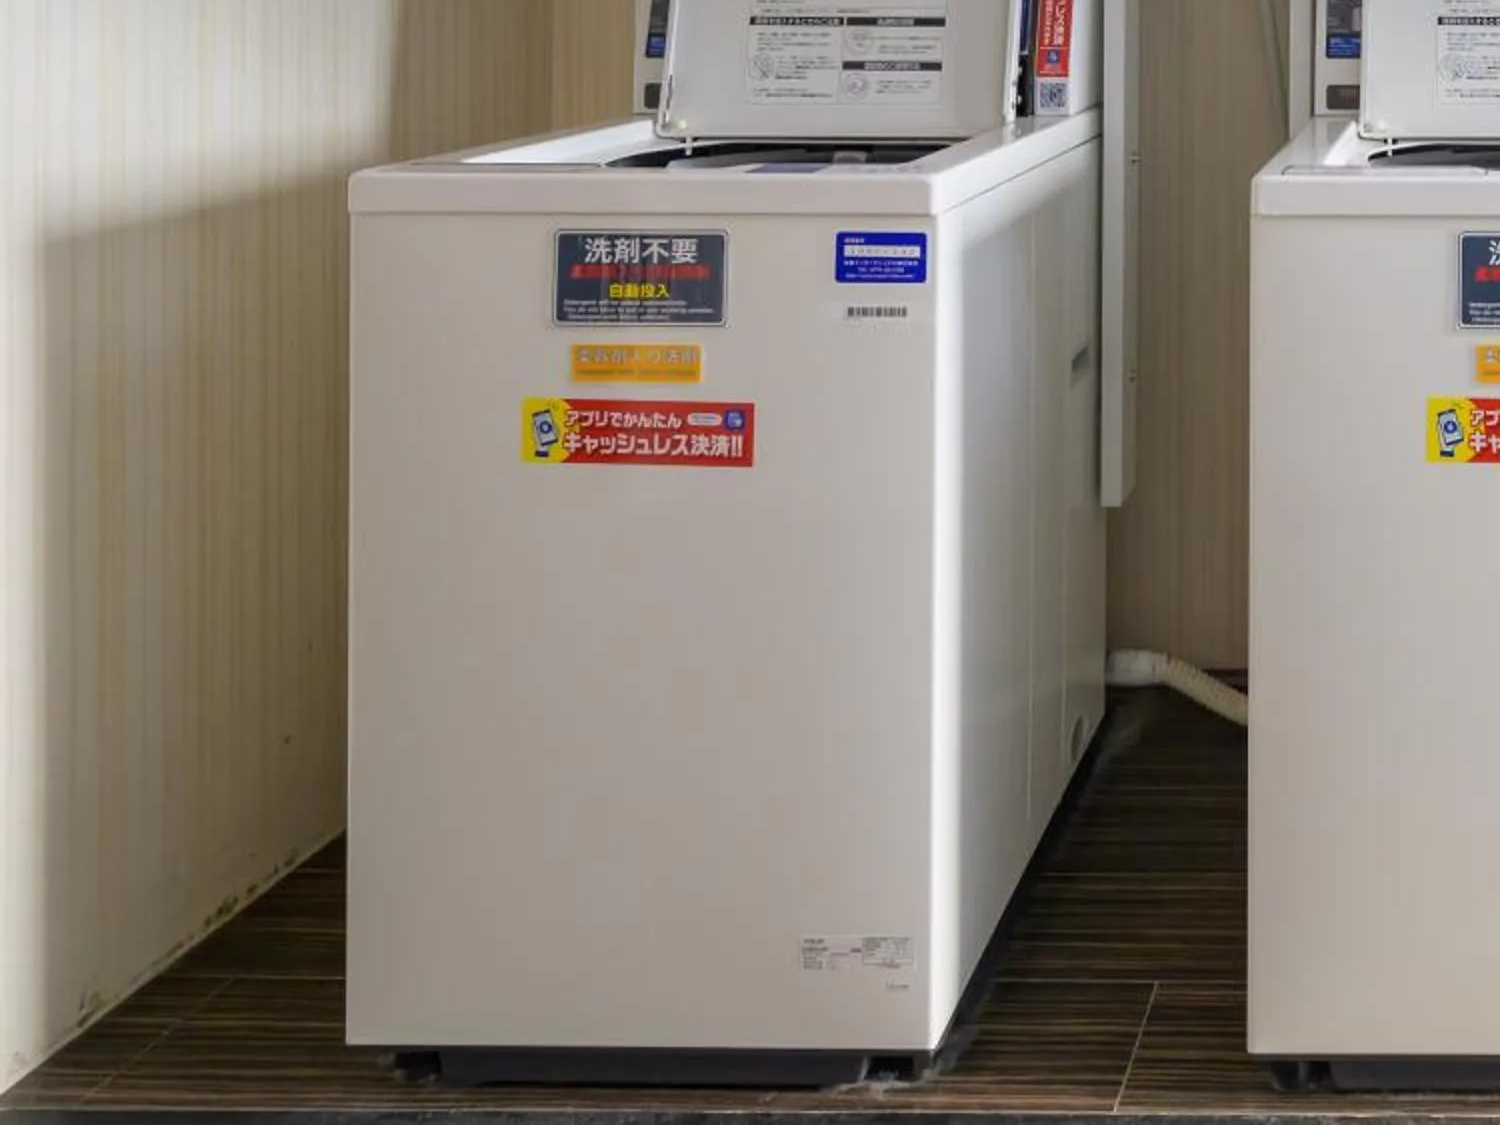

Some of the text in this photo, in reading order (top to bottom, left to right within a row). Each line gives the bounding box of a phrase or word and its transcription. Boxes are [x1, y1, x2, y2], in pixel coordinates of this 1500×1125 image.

[584, 237, 699, 264] 洗剤不要
[608, 283, 670, 299] 自動投入
[565, 410, 683, 429] アプリでかんたん
